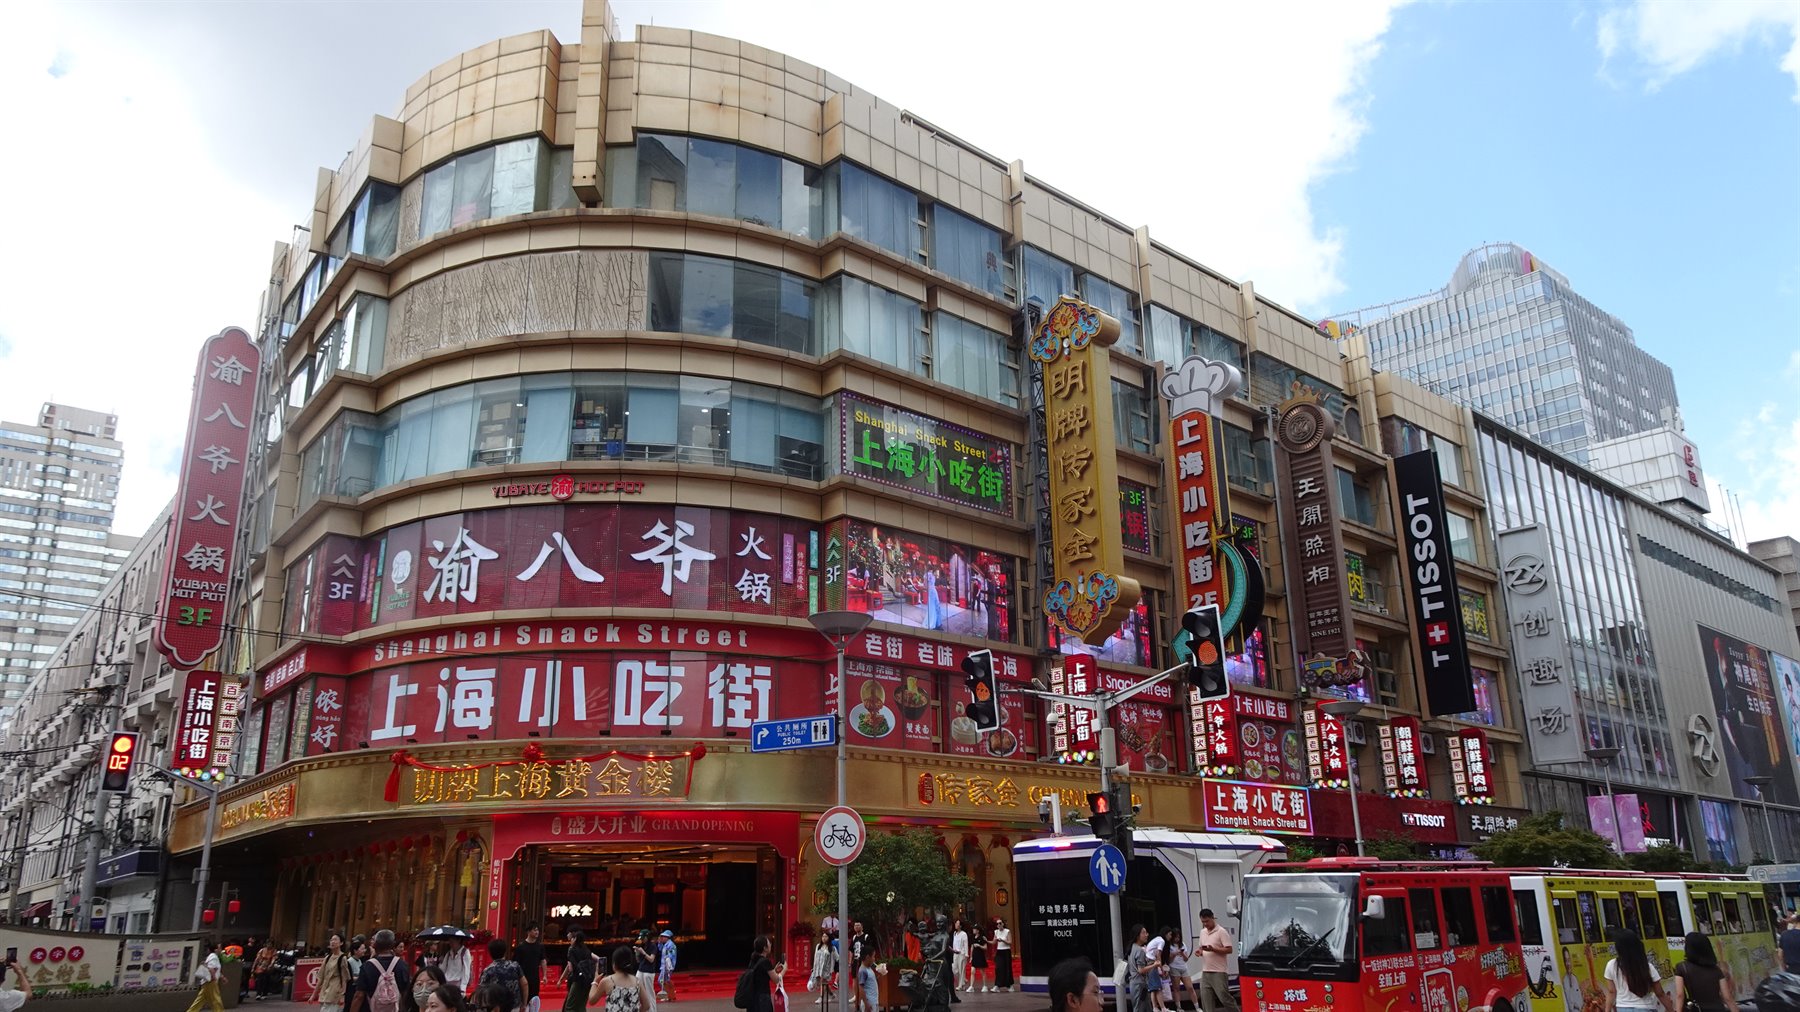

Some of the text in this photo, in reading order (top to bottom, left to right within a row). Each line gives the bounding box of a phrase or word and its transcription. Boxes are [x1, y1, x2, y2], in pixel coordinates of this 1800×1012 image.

[855, 410, 907, 436] Shanghai
[916, 429, 948, 448] Snack
[954, 440, 986, 460] Street
[183, 355, 252, 574] 渝八爷火锅
[852, 430, 1003, 502] 上海小吃街
[1050, 359, 1097, 563] 明牌传家金
[491, 482, 548, 498] YUBAYE
[579, 481, 645, 494] HOT POT
[1130, 491, 1141, 506] 3F
[1177, 419, 1213, 584] 上海小吃街
[1242, 527, 1253, 540] 3F
[1298, 477, 1331, 586] 王開照相
[423, 519, 716, 603] 渝八爷
[735, 526, 772, 605] 火锅
[1407, 493, 1446, 619] TISSOT
[826, 565, 841, 584] 3F
[171, 588, 226, 602] HOT POT
[173, 577, 227, 593] YUBAYE
[328, 582, 354, 600] 3F
[178, 606, 213, 626] 3F
[374, 623, 748, 661] Shanghai Snack Street
[866, 633, 902, 660] 老街
[918, 642, 953, 667] 老味
[1432, 650, 1451, 668] T
[371, 660, 772, 741] 上海小吃街
[189, 680, 216, 759] 上海小吃街
[217, 685, 237, 764] 百年南京路
[782, 736, 802, 746] 250m
[109, 754, 129, 770] 02
[1399, 727, 1417, 777] 朝鲜烤肉
[1468, 738, 1486, 786] 朝鲜烤肉
[935, 773, 1022, 807] 传家金
[1213, 785, 1305, 817] 上海小吃街
[568, 816, 646, 835] 盛大开业
[652, 818, 754, 832] GRAND OPENING
[1214, 814, 1250, 828] Shanghai
[1252, 816, 1274, 828] Snack
[1276, 817, 1297, 829] Street
[1415, 814, 1446, 828] TISSOT
[1039, 904, 1085, 914] 移动警务平台
[1053, 930, 1073, 938] POLICE
[1379, 972, 1407, 988] 全新上市
